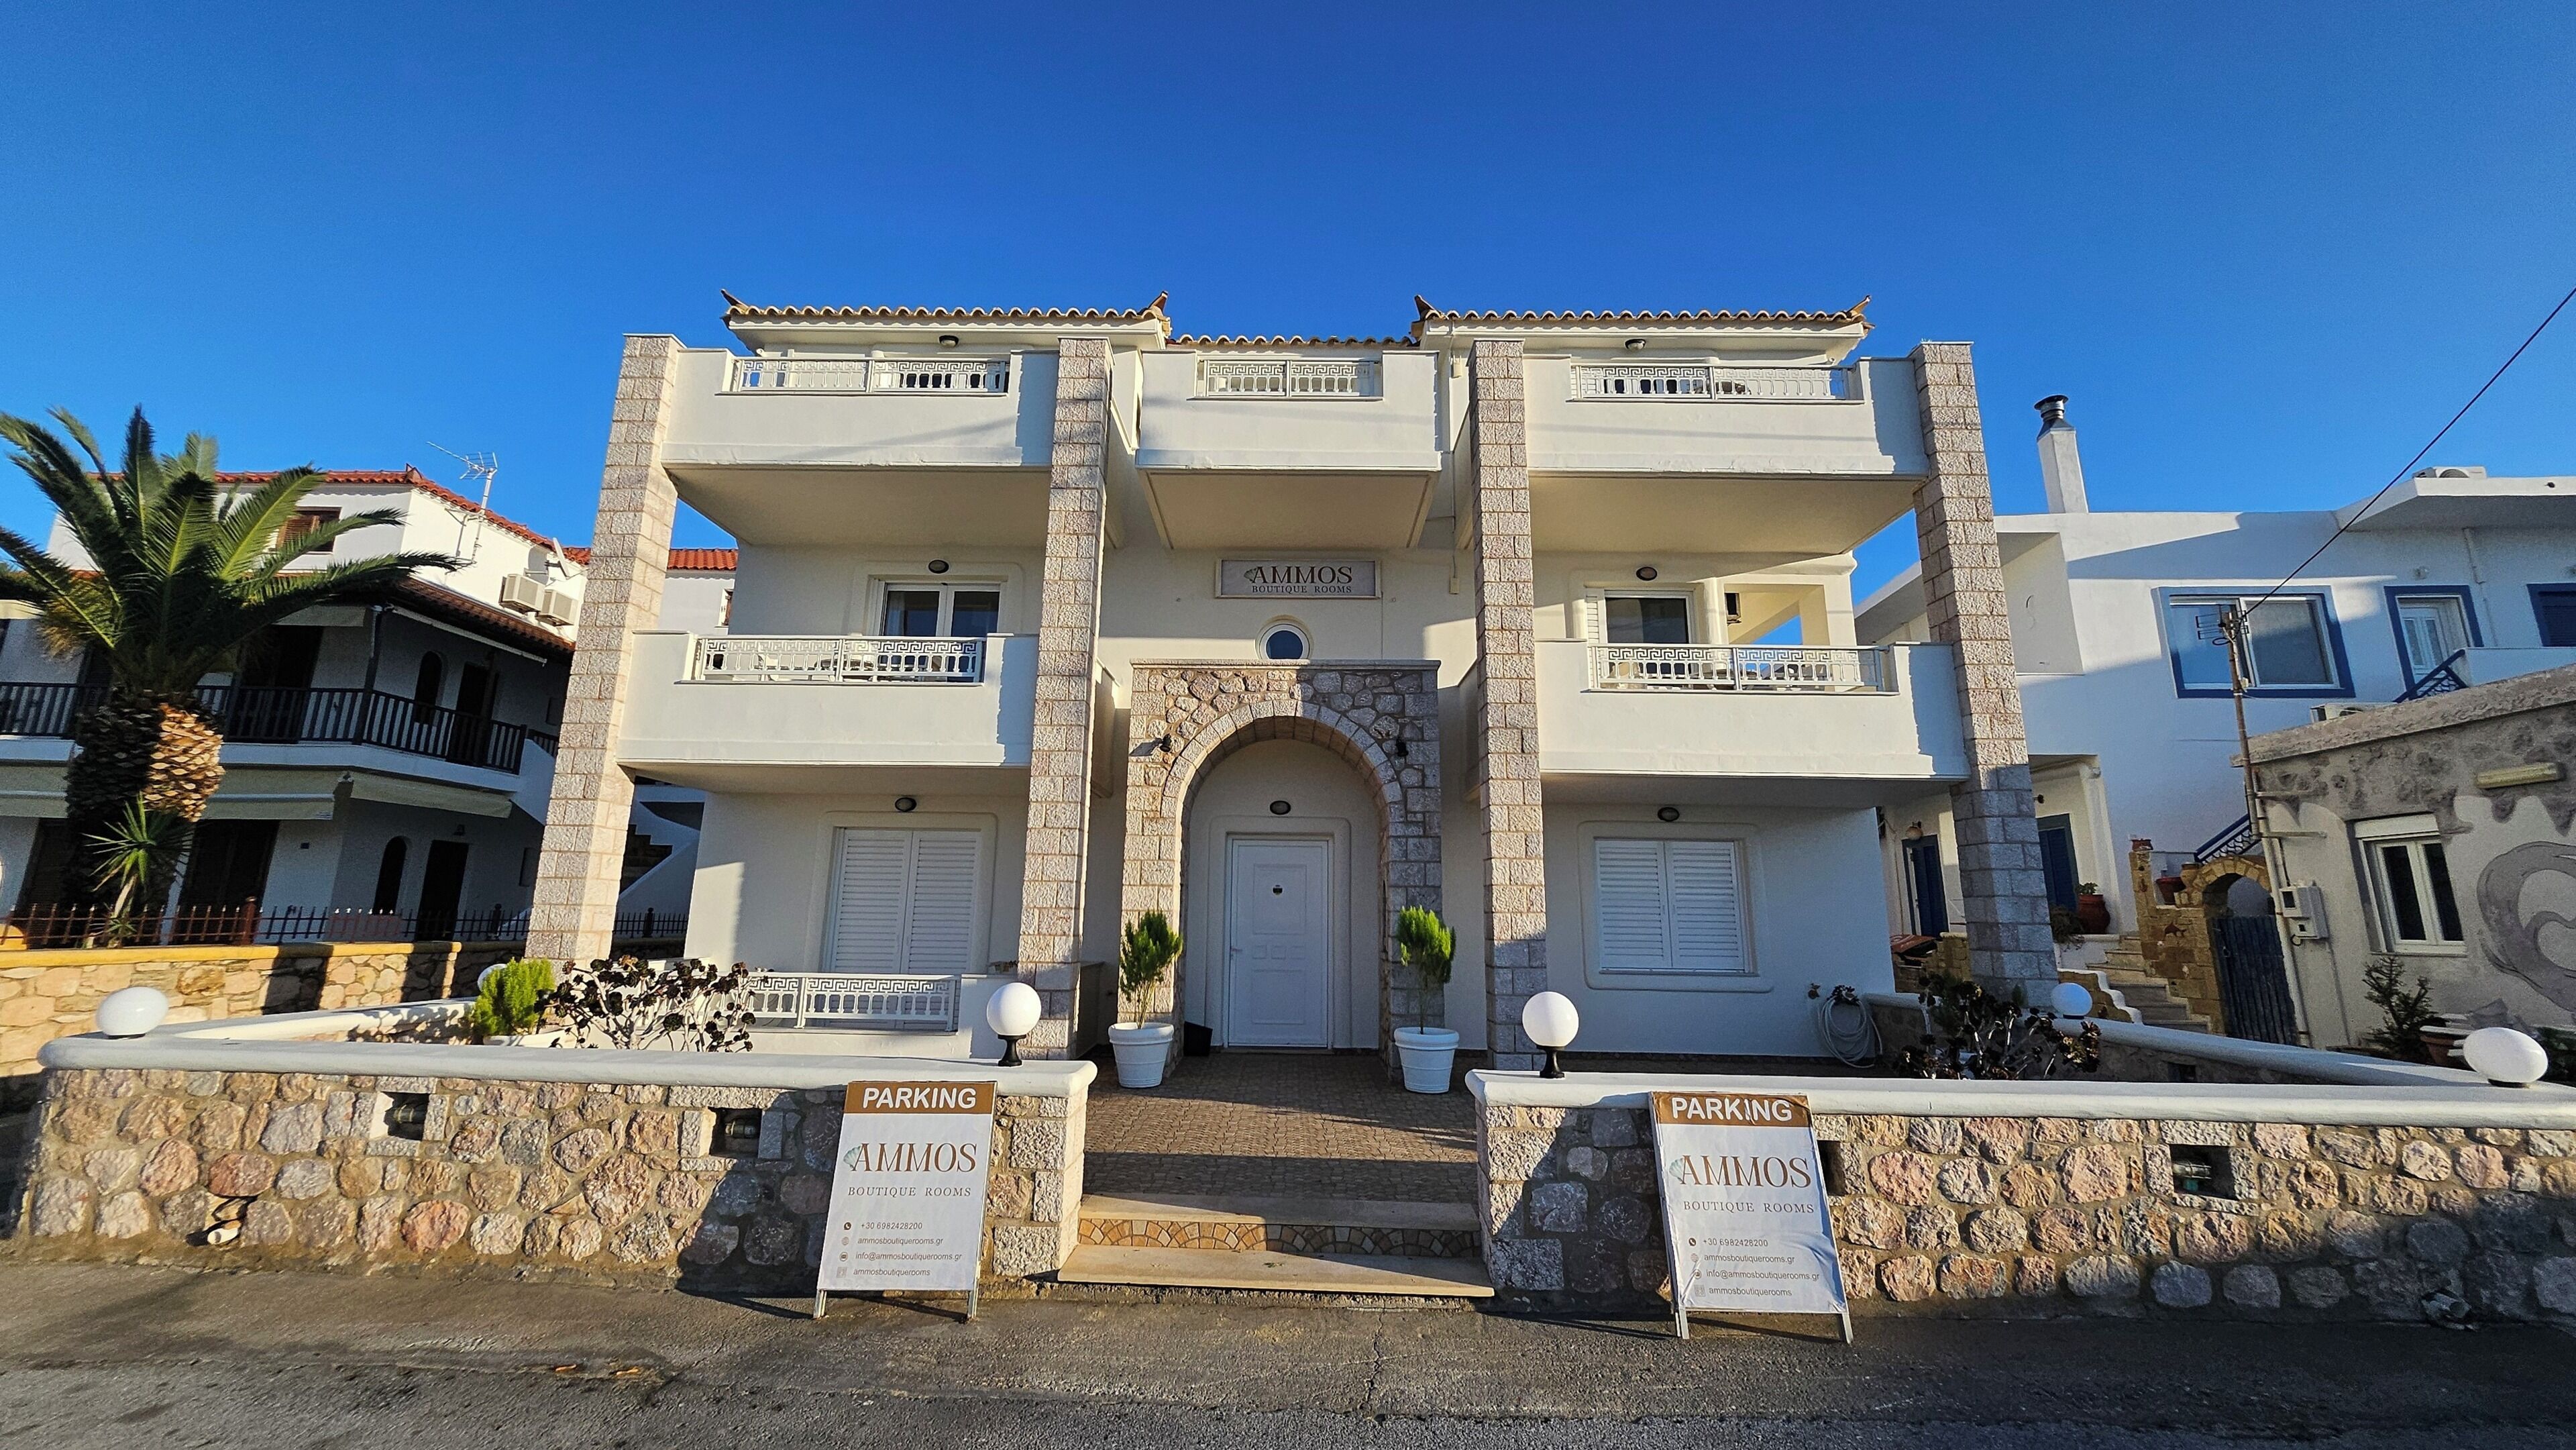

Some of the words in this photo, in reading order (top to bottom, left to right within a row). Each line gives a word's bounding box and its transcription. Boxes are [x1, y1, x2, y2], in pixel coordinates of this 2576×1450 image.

[1252, 566, 1352, 584] AMMOS
[1252, 585, 1307, 594] BOUTIQUE
[863, 1087, 977, 1108] PARKING
[1671, 1097, 1793, 1121] PARKING
[851, 1143, 977, 1172] AMMOS
[1680, 1155, 1811, 1188] AMMOS
[848, 1186, 916, 1197] BOUTIQUE
[925, 1187, 971, 1196] ROOMS
[1683, 1201, 1754, 1213] BOUTIQUE
[1764, 1202, 1814, 1213] ROOMS
[876, 1222, 922, 1230] 6982428200
[857, 1237, 943, 1245] ammosboutiquerooms.gr
[1703, 1238, 1717, 1246] +30
[1719, 1239, 1768, 1247] 6982428200
[855, 1251, 962, 1261] info@ammosboutiquerooms.gr
[1704, 1254, 1795, 1264] ammosboutiquerooms.gr
[853, 1268, 930, 1277] ammosboutiquerooms
[1706, 1270, 1820, 1282] info@ammosboutiquerooms.gr
[1709, 1286, 1792, 1296] ammosboutiquerooms
